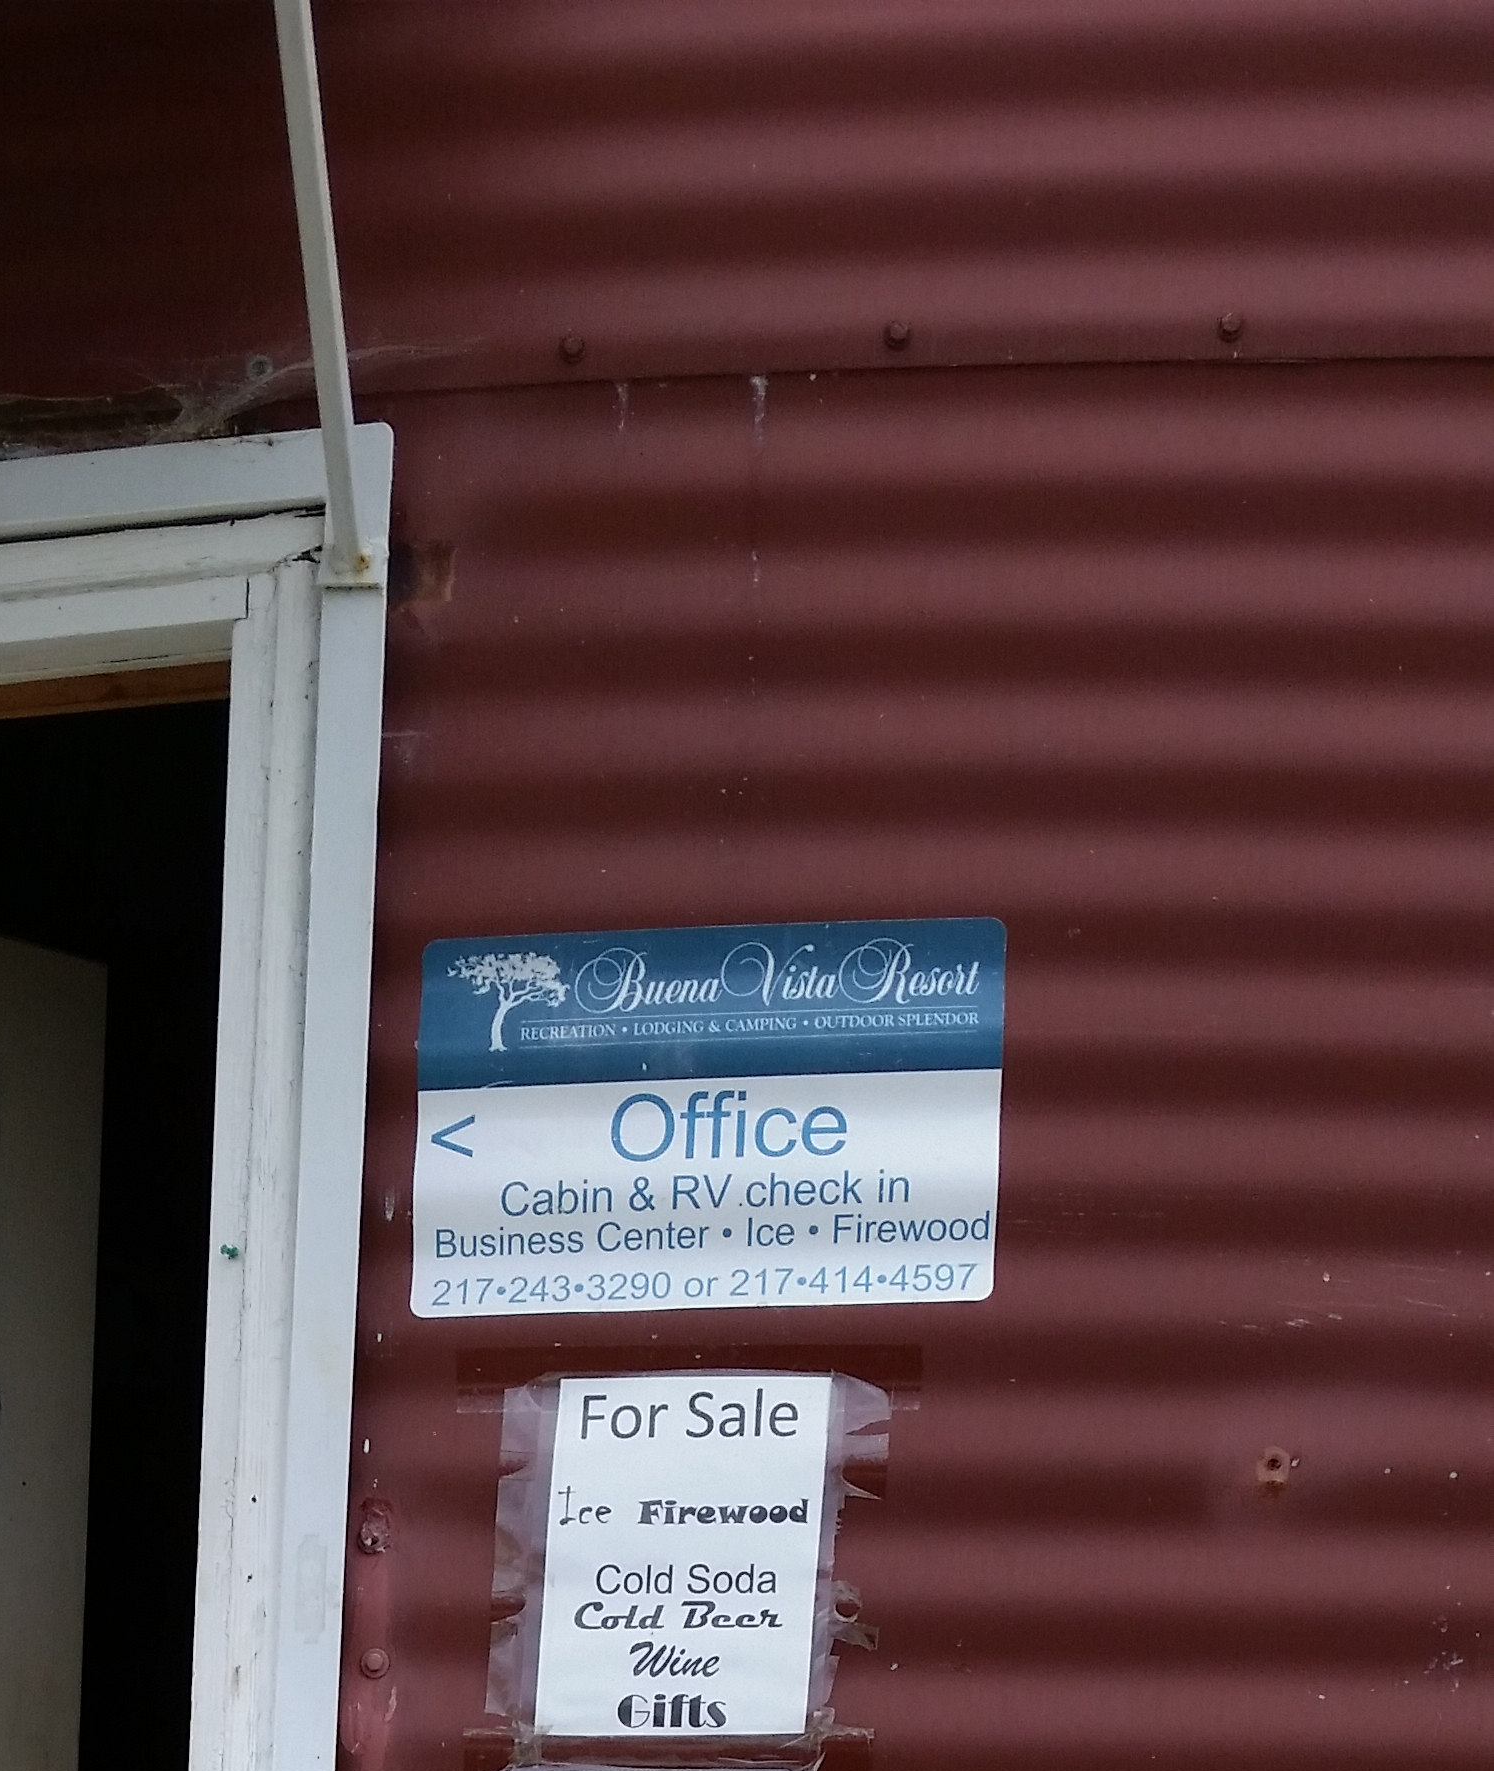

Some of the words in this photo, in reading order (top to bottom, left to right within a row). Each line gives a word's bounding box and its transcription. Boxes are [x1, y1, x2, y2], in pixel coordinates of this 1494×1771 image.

[575, 947, 723, 1013] Buena
[721, 942, 839, 1005] Vista
[838, 937, 980, 1004] Resort
[520, 1022, 616, 1041] RECREATION
[634, 1019, 704, 1036] LODGING
[709, 1019, 721, 1034] &
[724, 1016, 797, 1033] CAMPING
[814, 1013, 895, 1030] OUTDOOR
[898, 1011, 980, 1028] SPLENDOR
[611, 1090, 847, 1162] Office
[501, 1178, 613, 1217] Cabin
[629, 1177, 657, 1211] &
[672, 1174, 731, 1210] RV
[745, 1170, 862, 1207] check
[879, 1169, 910, 1203] in
[436, 1223, 584, 1258] Business
[597, 1218, 710, 1252] Center
[746, 1216, 796, 1247] Ice
[832, 1210, 990, 1245] Firewood
[684, 1274, 718, 1298] or
[581, 1394, 668, 1439] For
[686, 1388, 799, 1437] Sale
[558, 1485, 612, 1526] Ice
[637, 1498, 809, 1525] Firewood
[596, 1564, 673, 1594] Cold
[687, 1564, 777, 1594] Soda
[574, 1601, 664, 1630] Cold
[681, 1601, 783, 1629] Beer
[629, 1641, 720, 1677] Wine
[617, 1694, 727, 1729] Gifts
